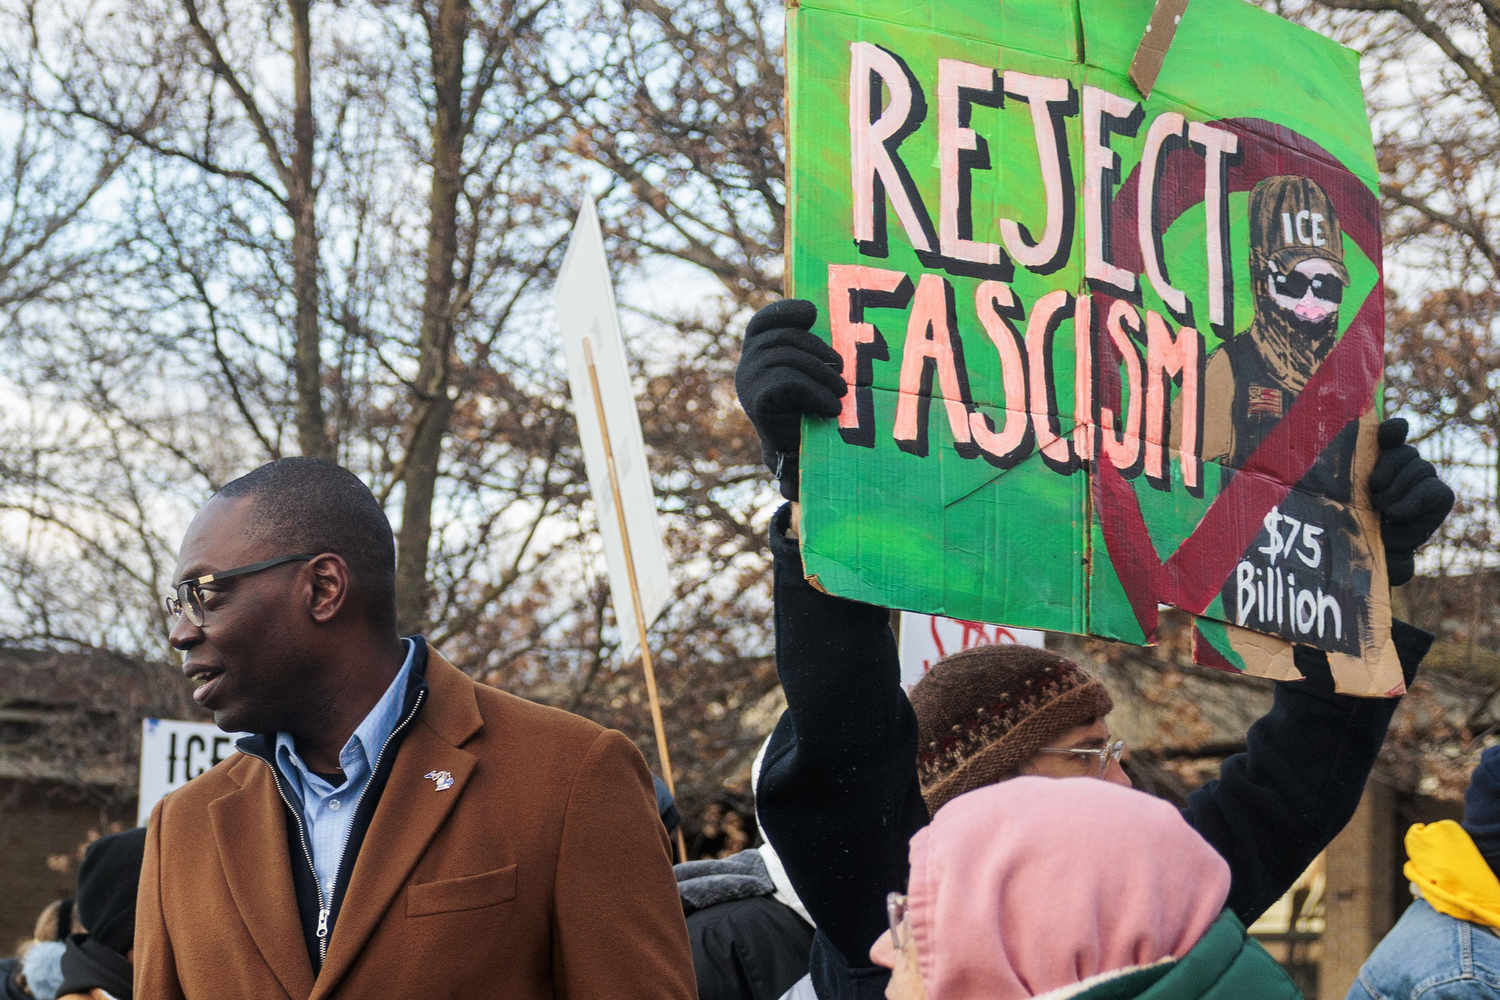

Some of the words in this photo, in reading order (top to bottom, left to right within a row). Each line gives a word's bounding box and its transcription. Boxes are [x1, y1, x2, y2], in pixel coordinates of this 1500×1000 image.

[850, 41, 1243, 335] REJECT
[1282, 209, 1327, 247] ICE
[828, 264, 1202, 494] FASCISM
[1258, 506, 1325, 569] $75
[1236, 560, 1343, 640] Billion
